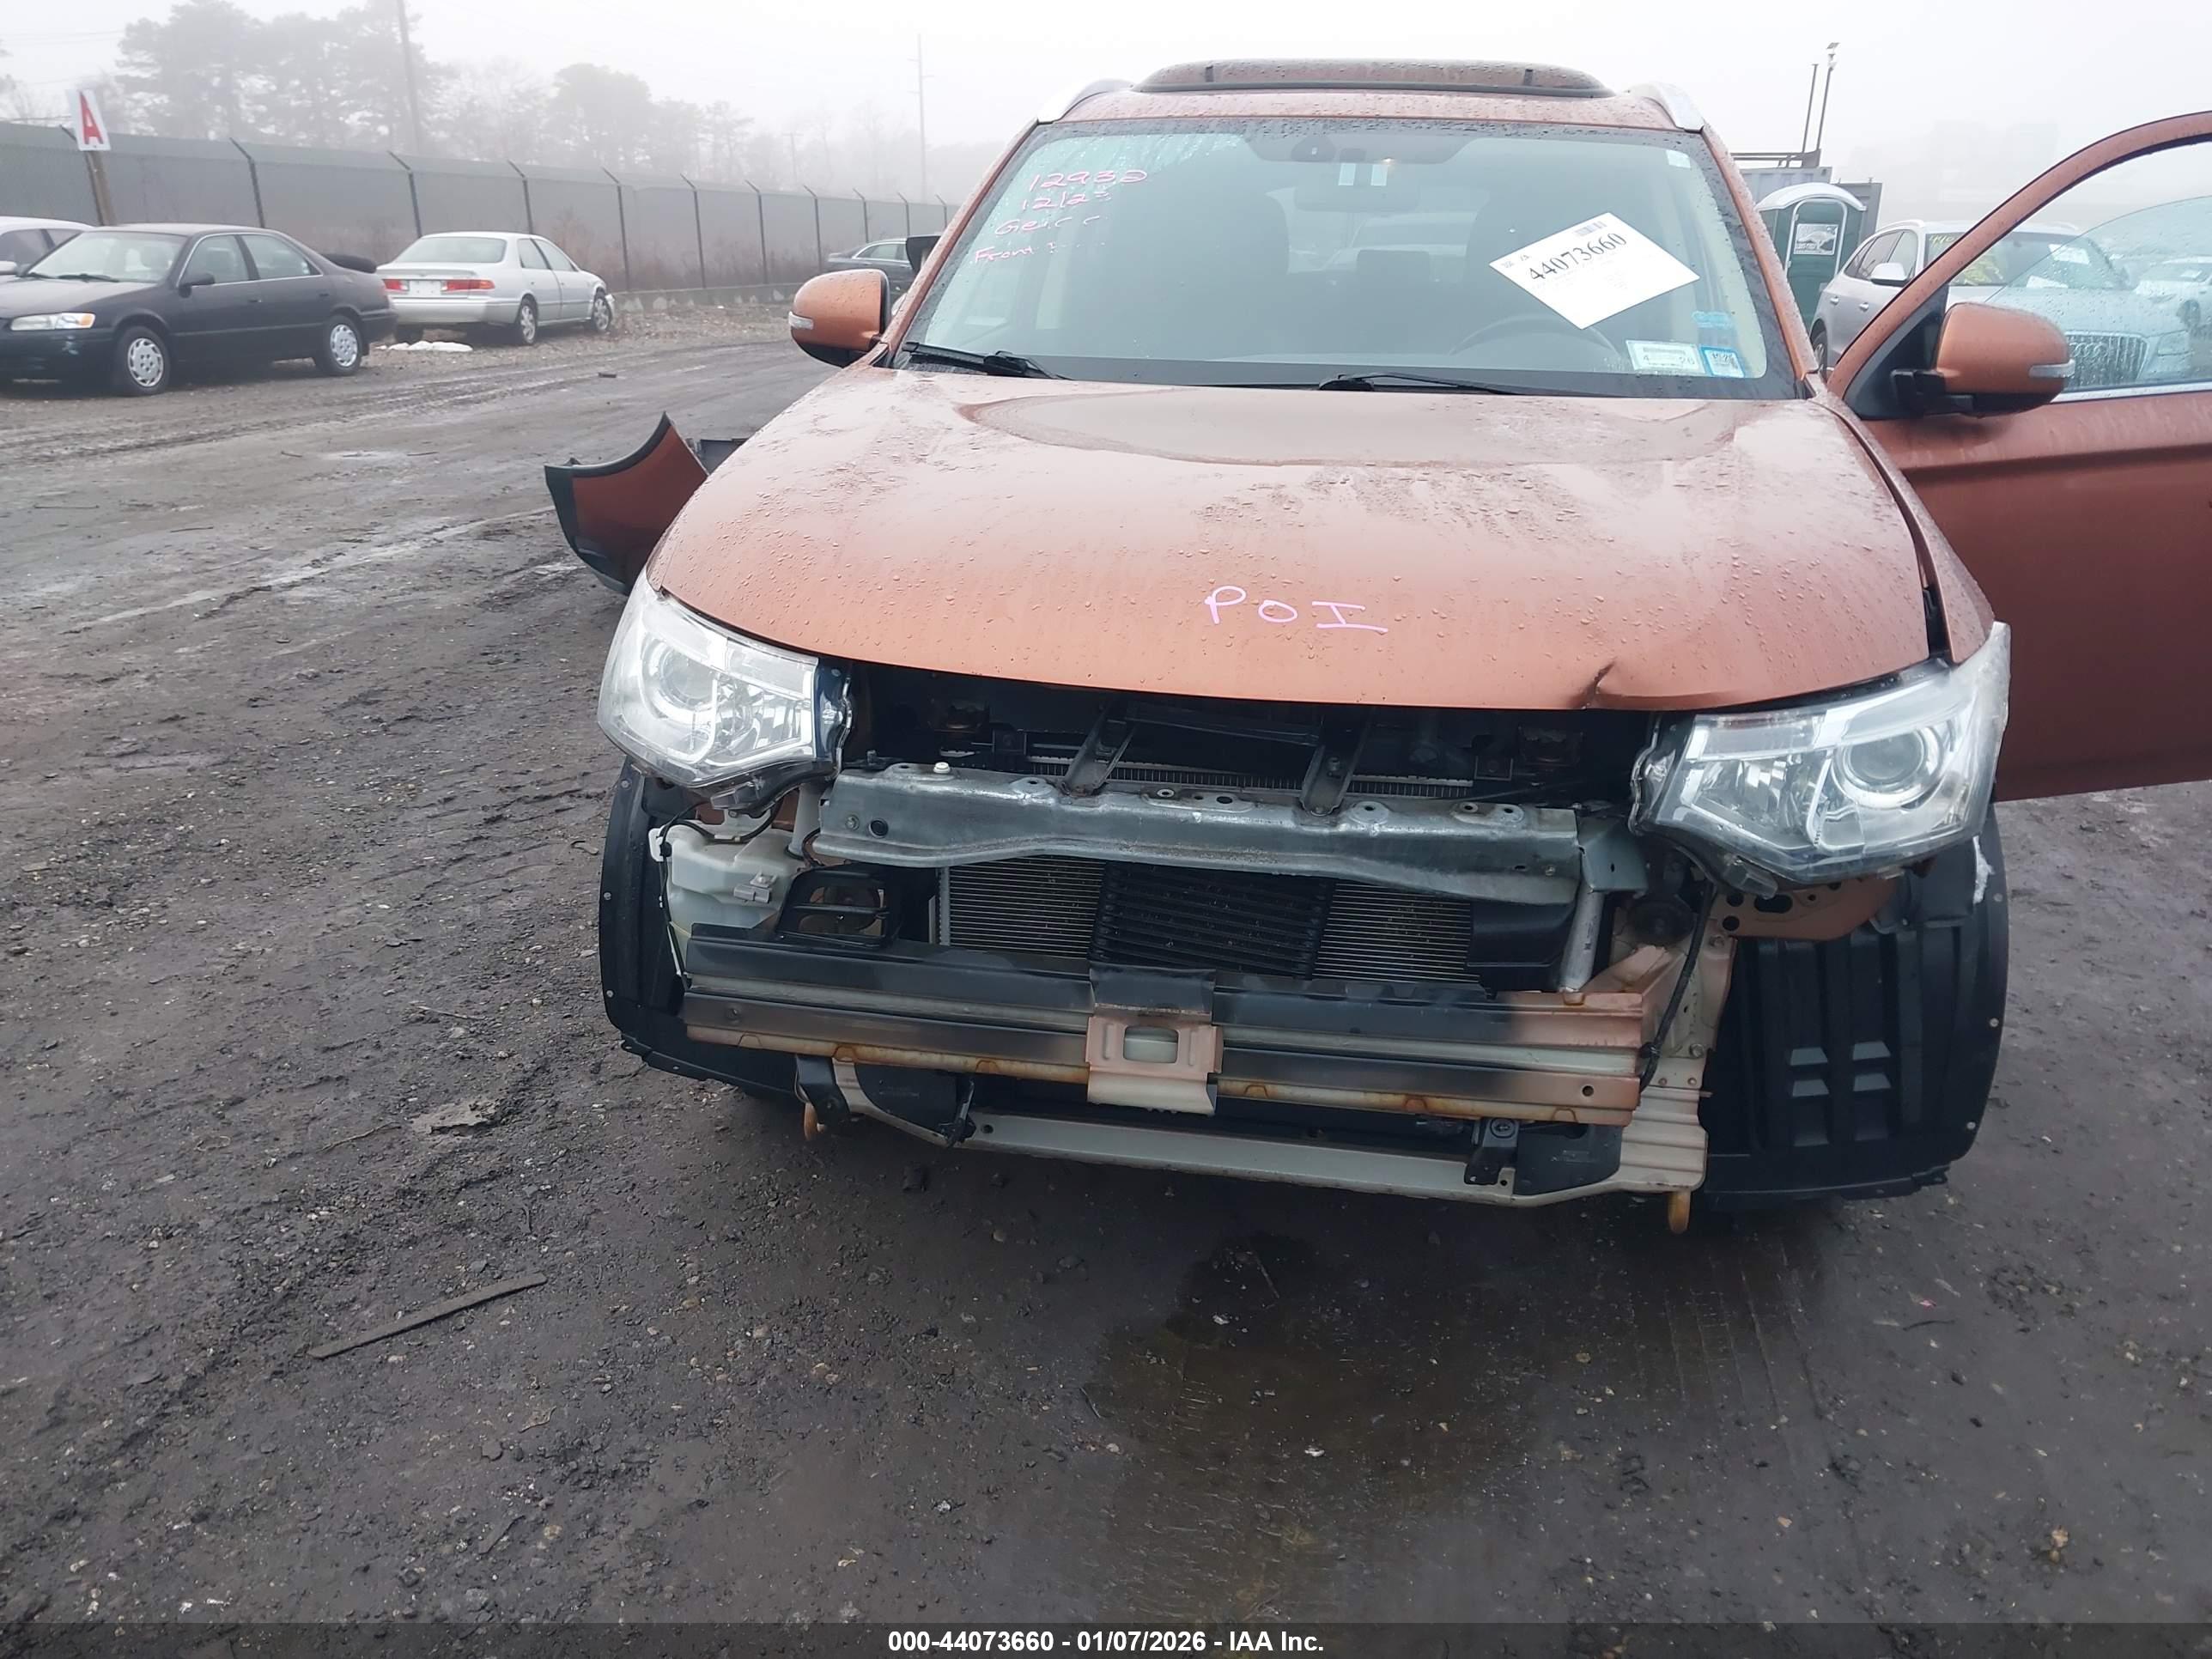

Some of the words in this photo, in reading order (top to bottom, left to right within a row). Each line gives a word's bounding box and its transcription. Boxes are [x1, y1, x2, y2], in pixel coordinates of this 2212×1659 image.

[79, 91, 104, 144] A
[1529, 233, 1627, 280] 44073660
[1204, 585, 1389, 633] POI
